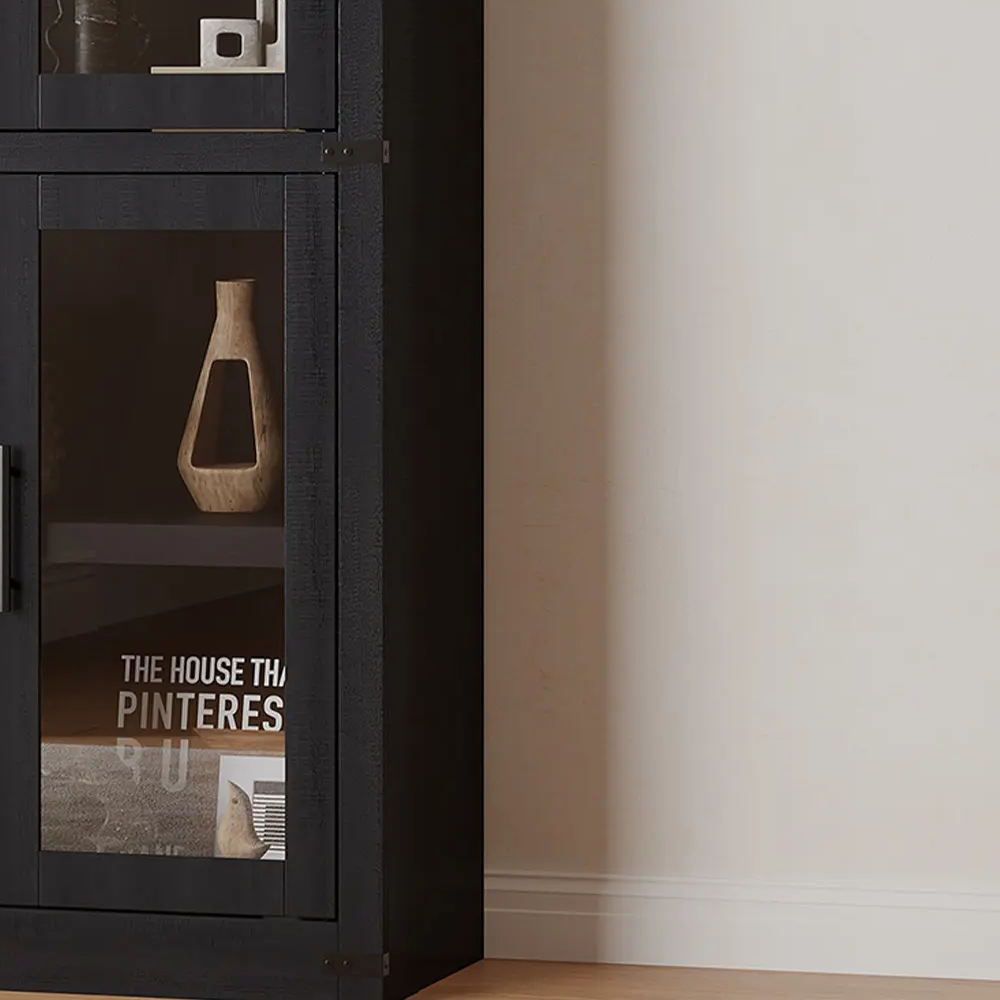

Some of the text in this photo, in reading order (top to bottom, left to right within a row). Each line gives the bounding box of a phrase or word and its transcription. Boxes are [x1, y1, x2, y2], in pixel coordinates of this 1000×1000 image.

[121, 654, 164, 683] THE
[170, 656, 245, 686] HOUSE
[117, 691, 284, 732] PINTERES
